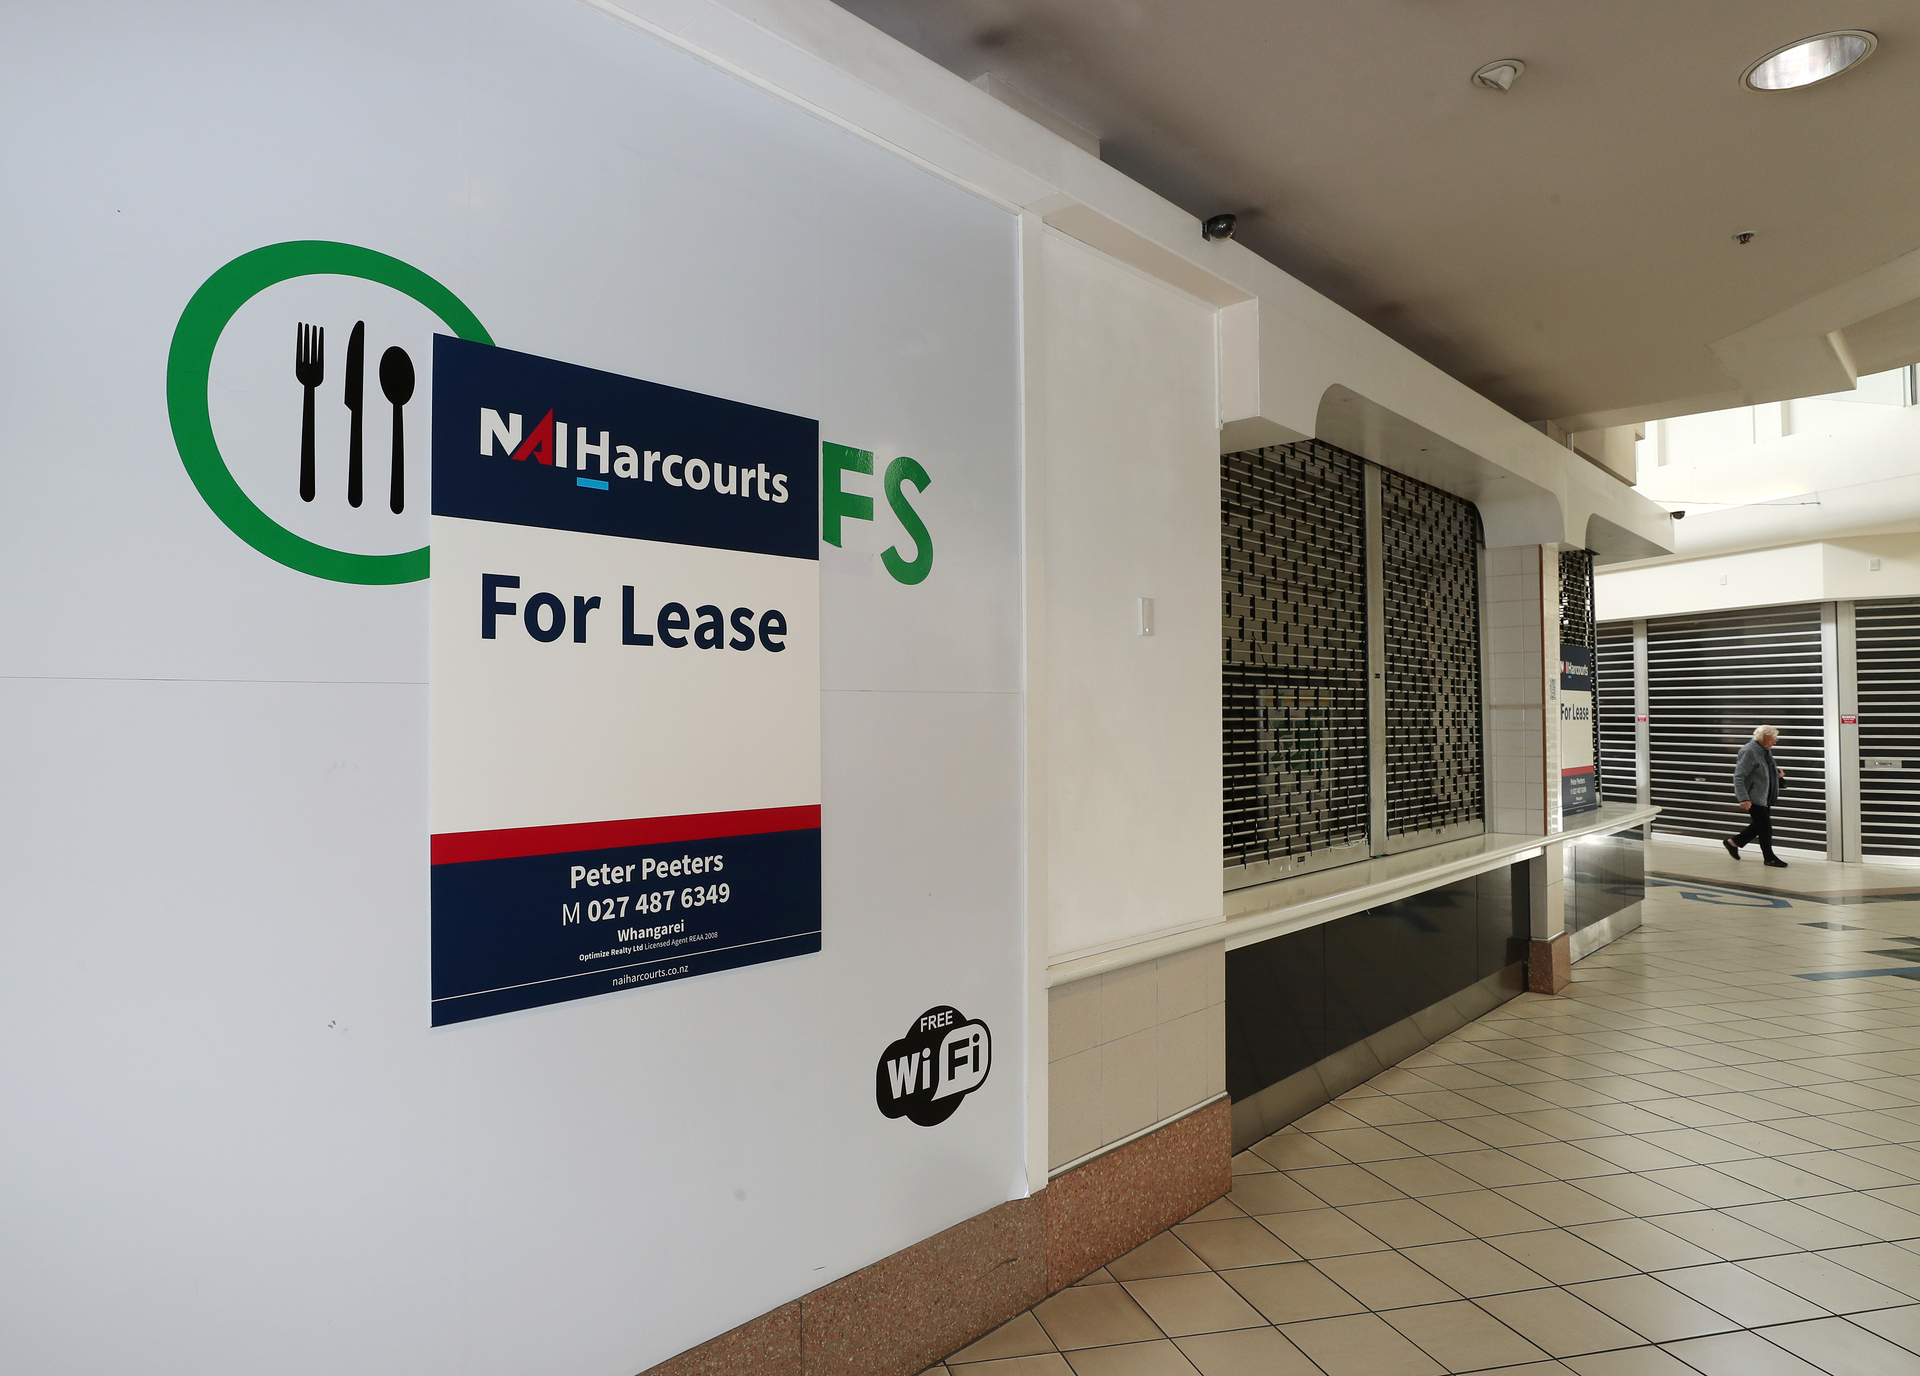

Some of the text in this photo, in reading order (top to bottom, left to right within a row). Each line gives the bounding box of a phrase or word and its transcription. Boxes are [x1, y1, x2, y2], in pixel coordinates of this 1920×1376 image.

[481, 572, 788, 653] For Lease
[1561, 703, 1589, 721] For Lease
[570, 854, 724, 889] Peter Peeters
[562, 882, 731, 926] M 027 487 6349
[617, 919, 685, 942] Whangarei
[579, 931, 719, 962] Optimize Realty Ltd Licensed Agent REAA 2008
[612, 964, 689, 987] naiharcourts.co.nz
[920, 1010, 954, 1033] FREE
